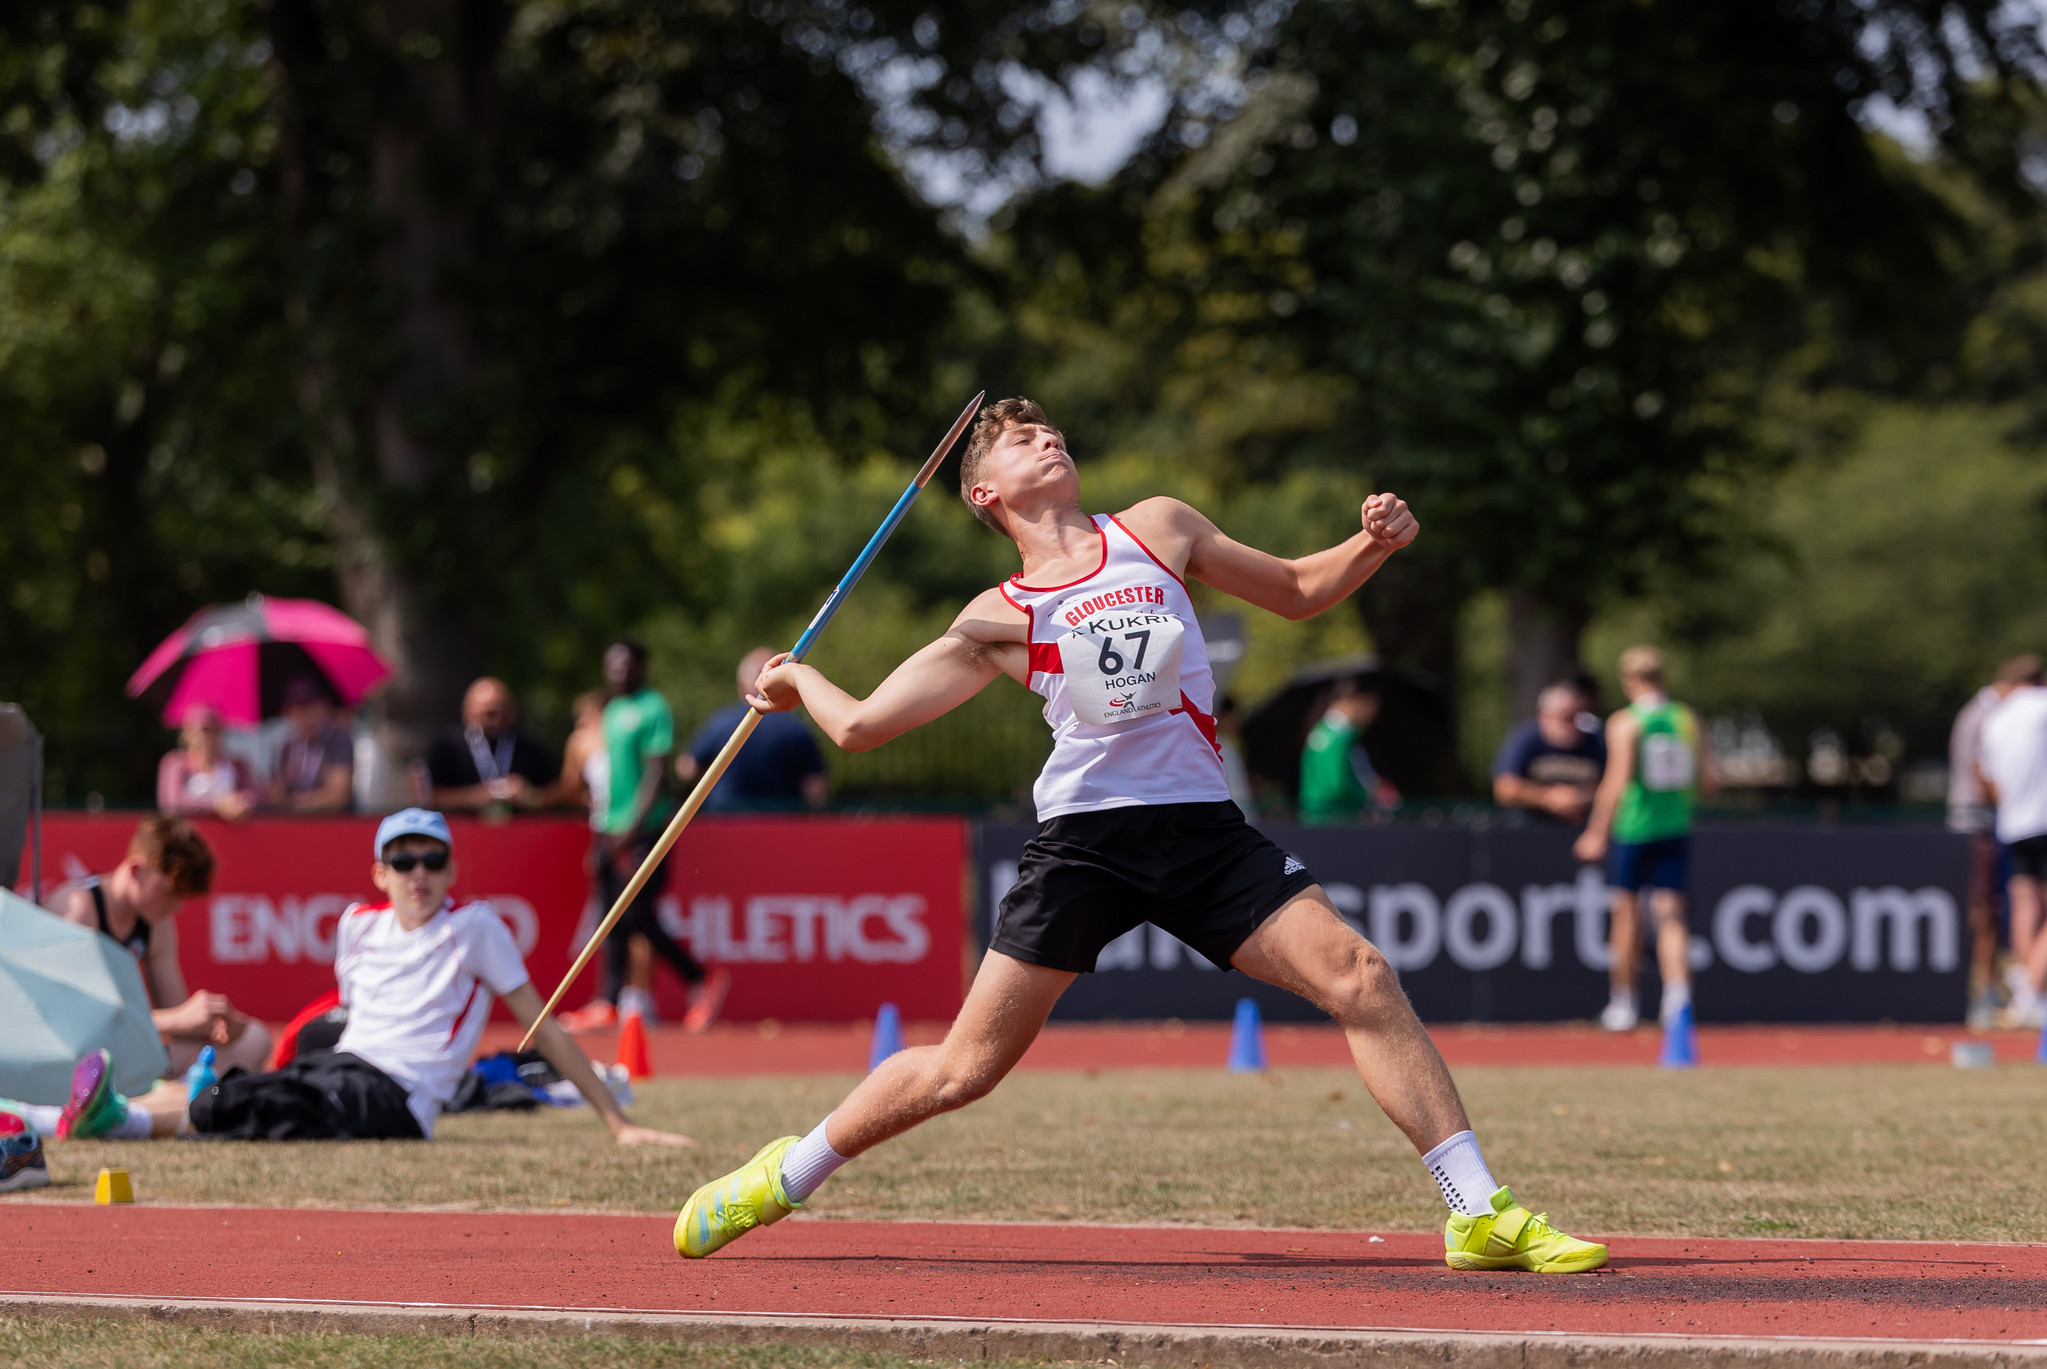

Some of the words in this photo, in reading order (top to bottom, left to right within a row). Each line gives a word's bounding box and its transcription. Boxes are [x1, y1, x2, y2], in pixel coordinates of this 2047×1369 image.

[1065, 586, 1164, 626] GLOUCESTER
[1088, 615, 1168, 634] KUKRI
[1098, 629, 1151, 675] 67
[1105, 672, 1156, 690] HOGAN
[1104, 707, 1134, 718] ENGLAND
[1137, 702, 1161, 712] ATHLETICS
[568, 894, 930, 962] HLETICS
